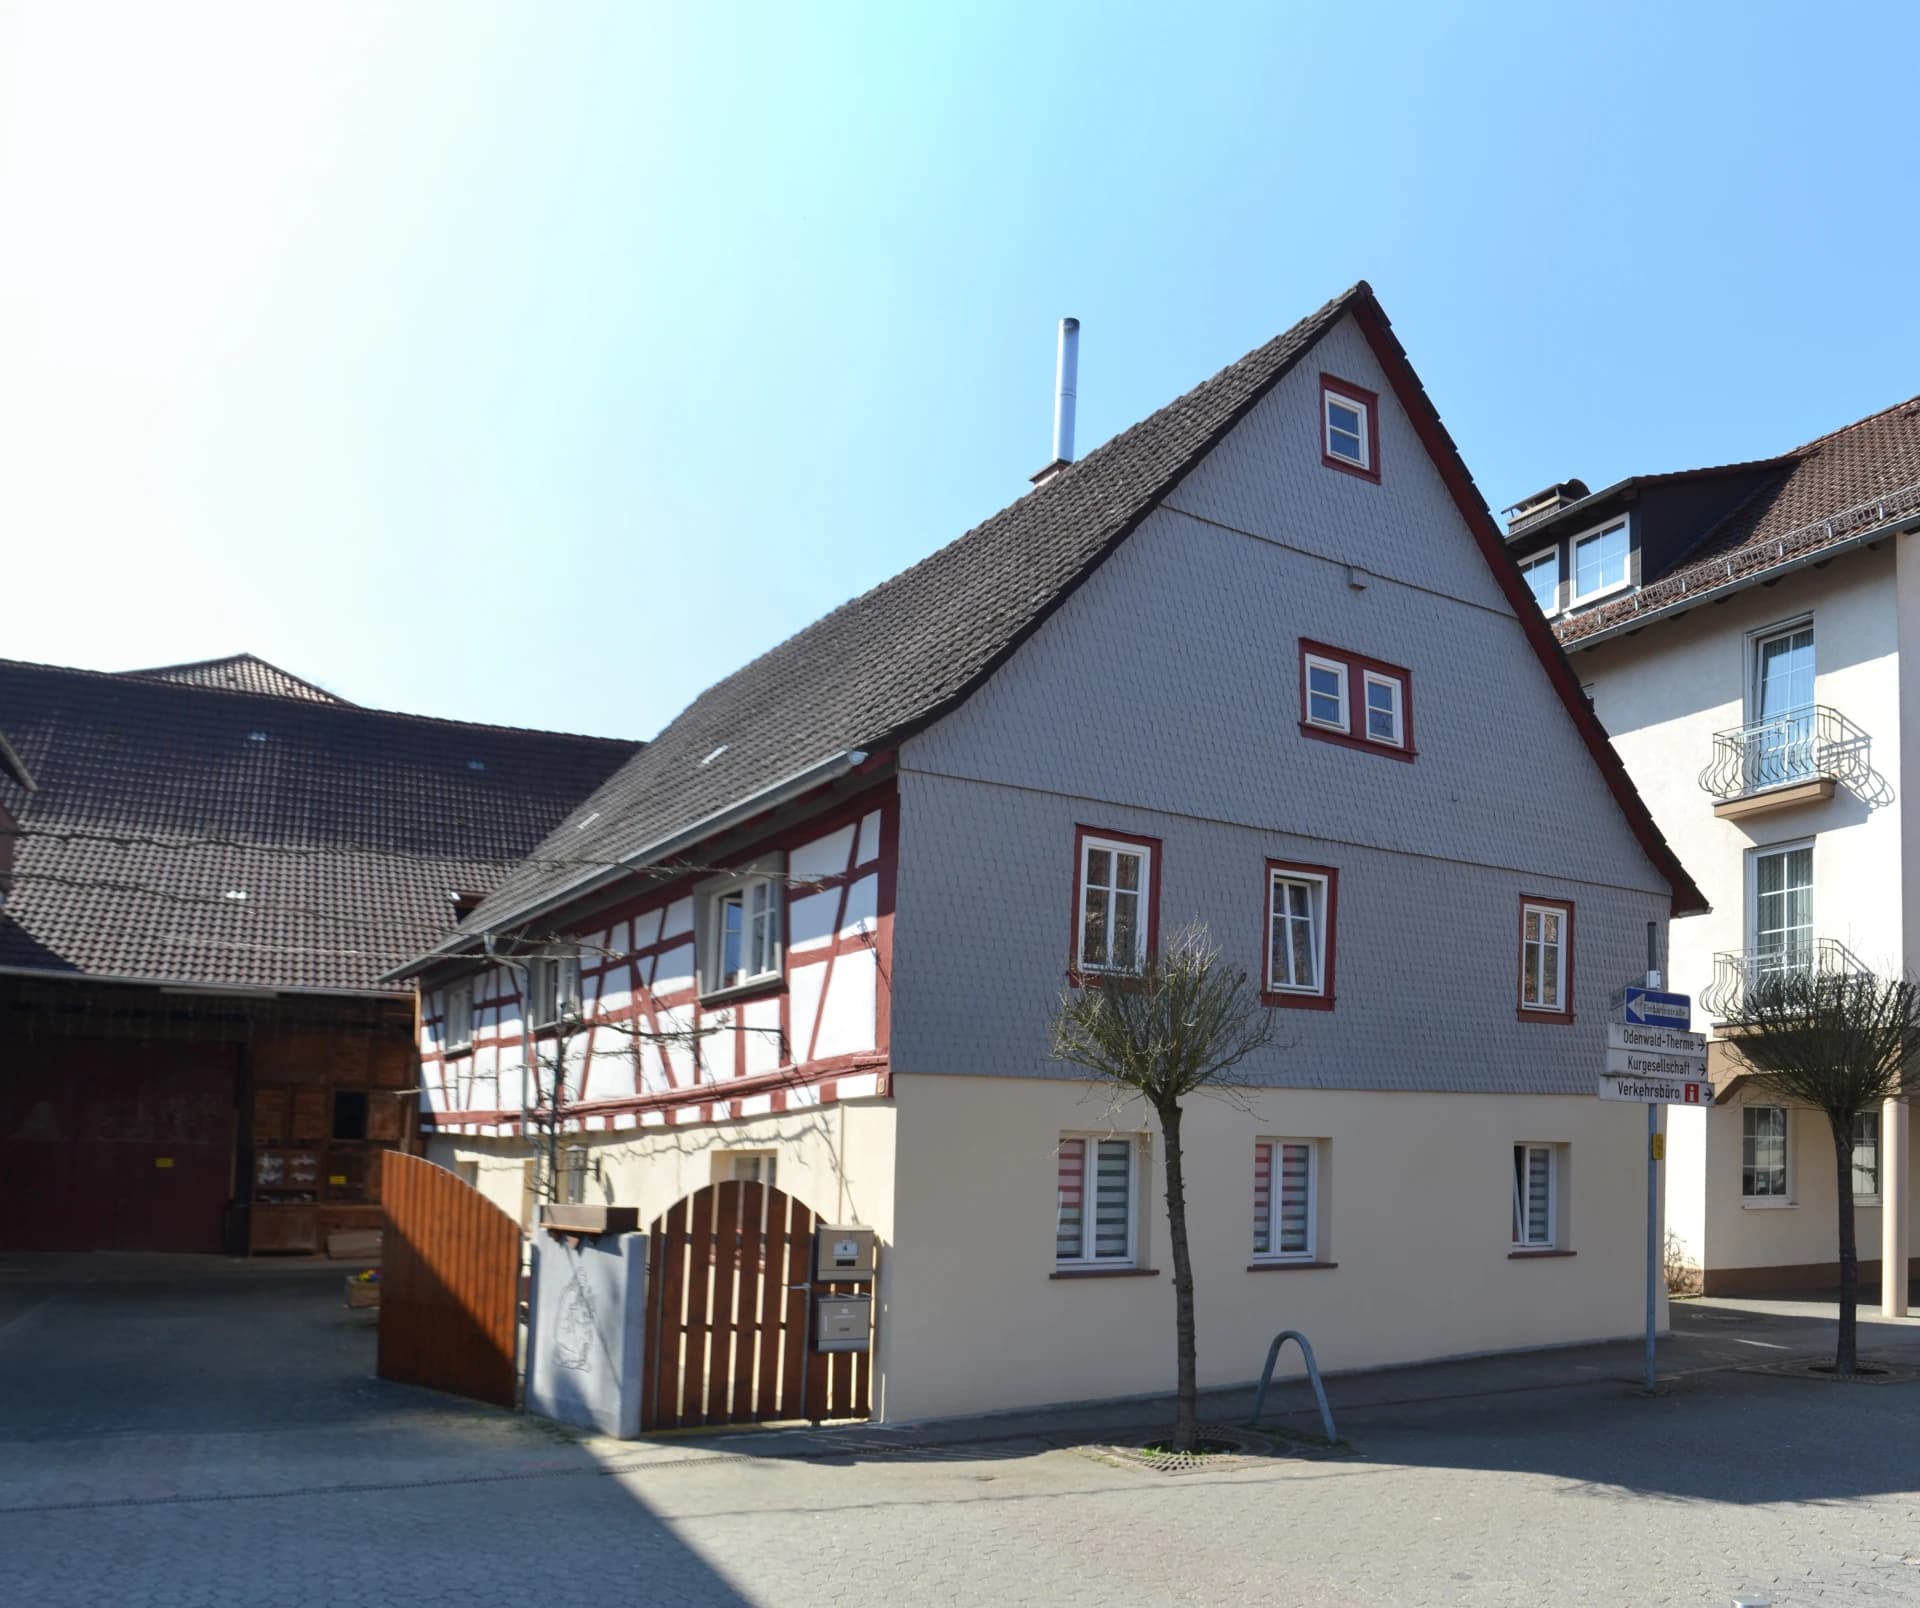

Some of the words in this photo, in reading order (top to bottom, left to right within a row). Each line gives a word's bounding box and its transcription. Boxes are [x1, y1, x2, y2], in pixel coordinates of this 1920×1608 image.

[1623, 1029, 1694, 1050] Odenwald-Therme
[1627, 1055, 1691, 1075] Kurgesellschaft
[1617, 1080, 1680, 1099] Verkehrsbüro
